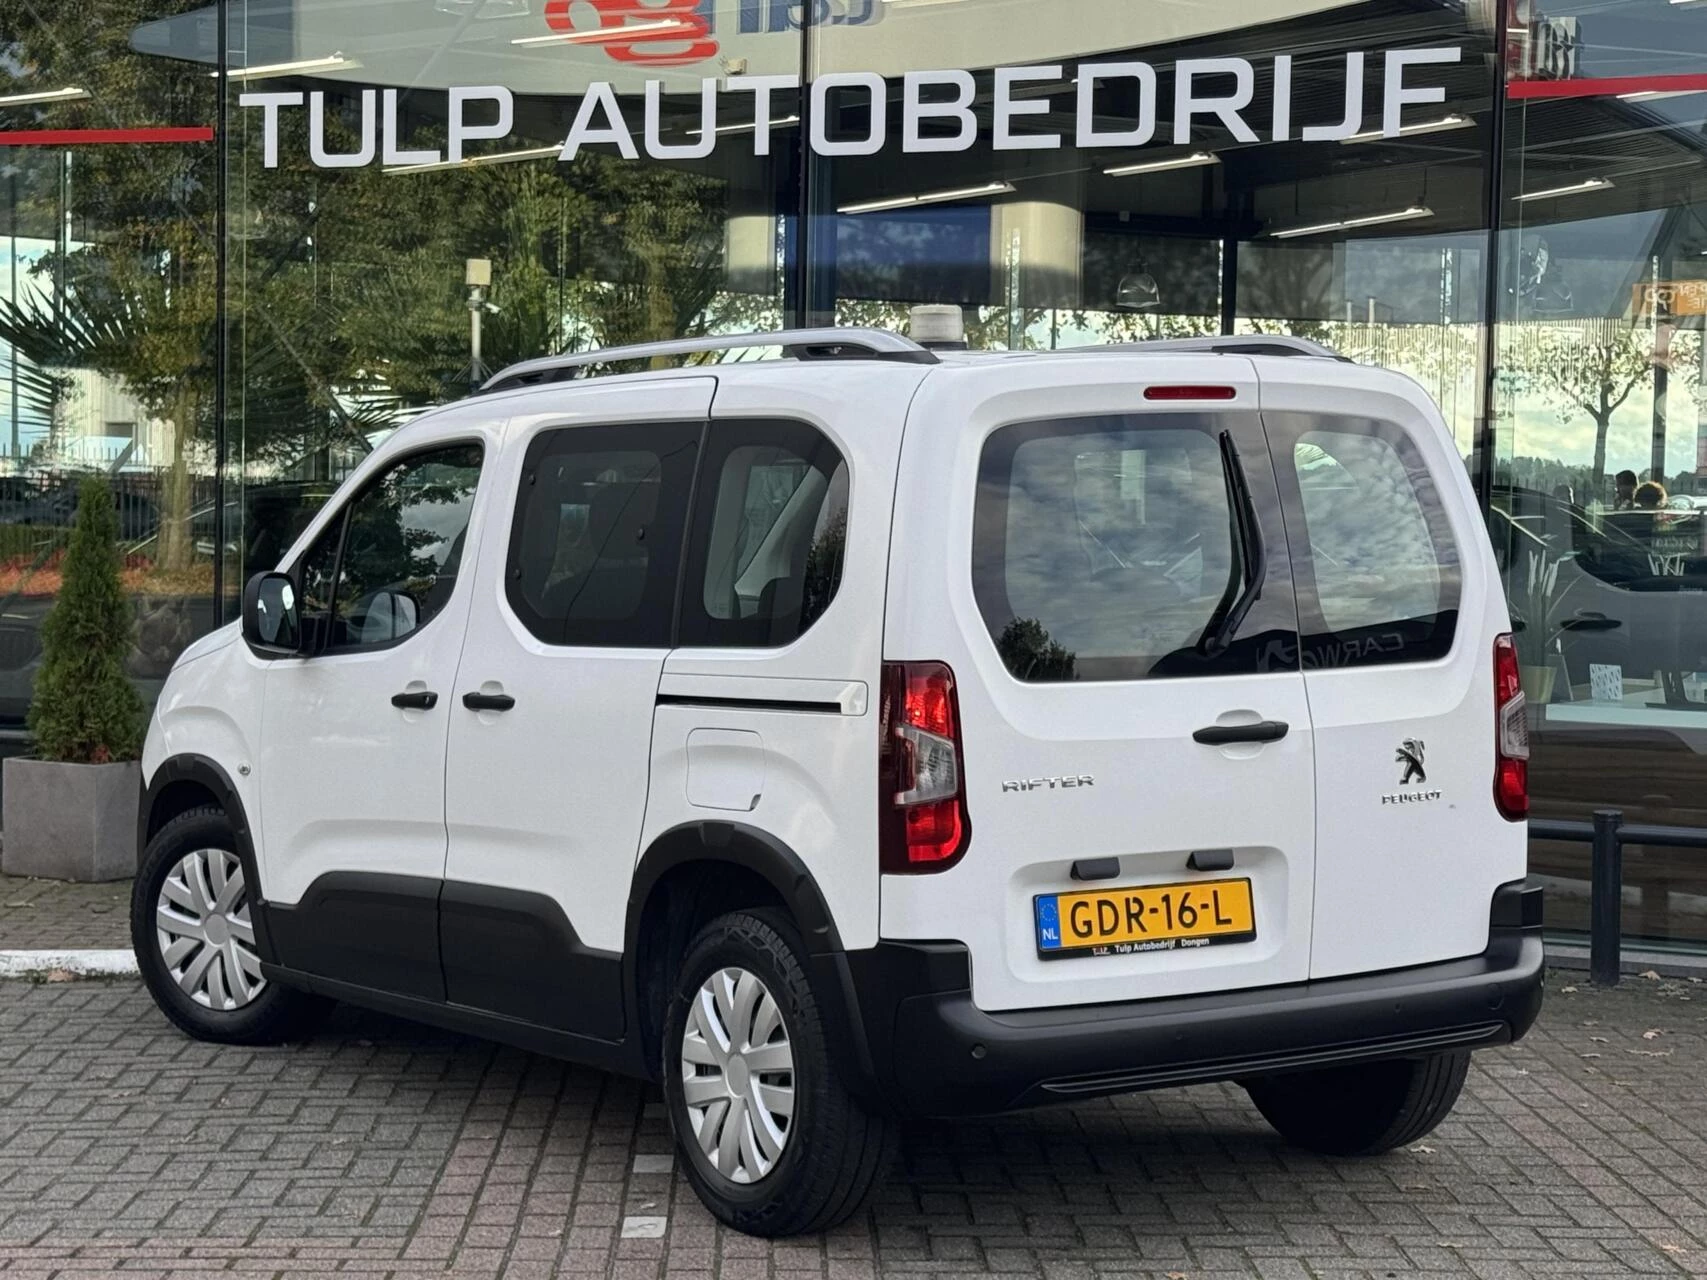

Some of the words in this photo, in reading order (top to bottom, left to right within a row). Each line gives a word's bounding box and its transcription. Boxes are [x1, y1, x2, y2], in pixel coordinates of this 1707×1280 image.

[239, 85, 514, 168] TULP
[558, 47, 1462, 161] AUTOBEDRIJF
[1001, 774, 1095, 793] RIFTER
[1381, 790, 1442, 805] PEUGEOT
[1042, 927, 1059, 941] NL
[1070, 889, 1233, 939] GDR-16-L
[1114, 944, 1132, 955] Tulp
[1133, 938, 1176, 952] Autobedrijf
[1181, 937, 1210, 949] Dongen
